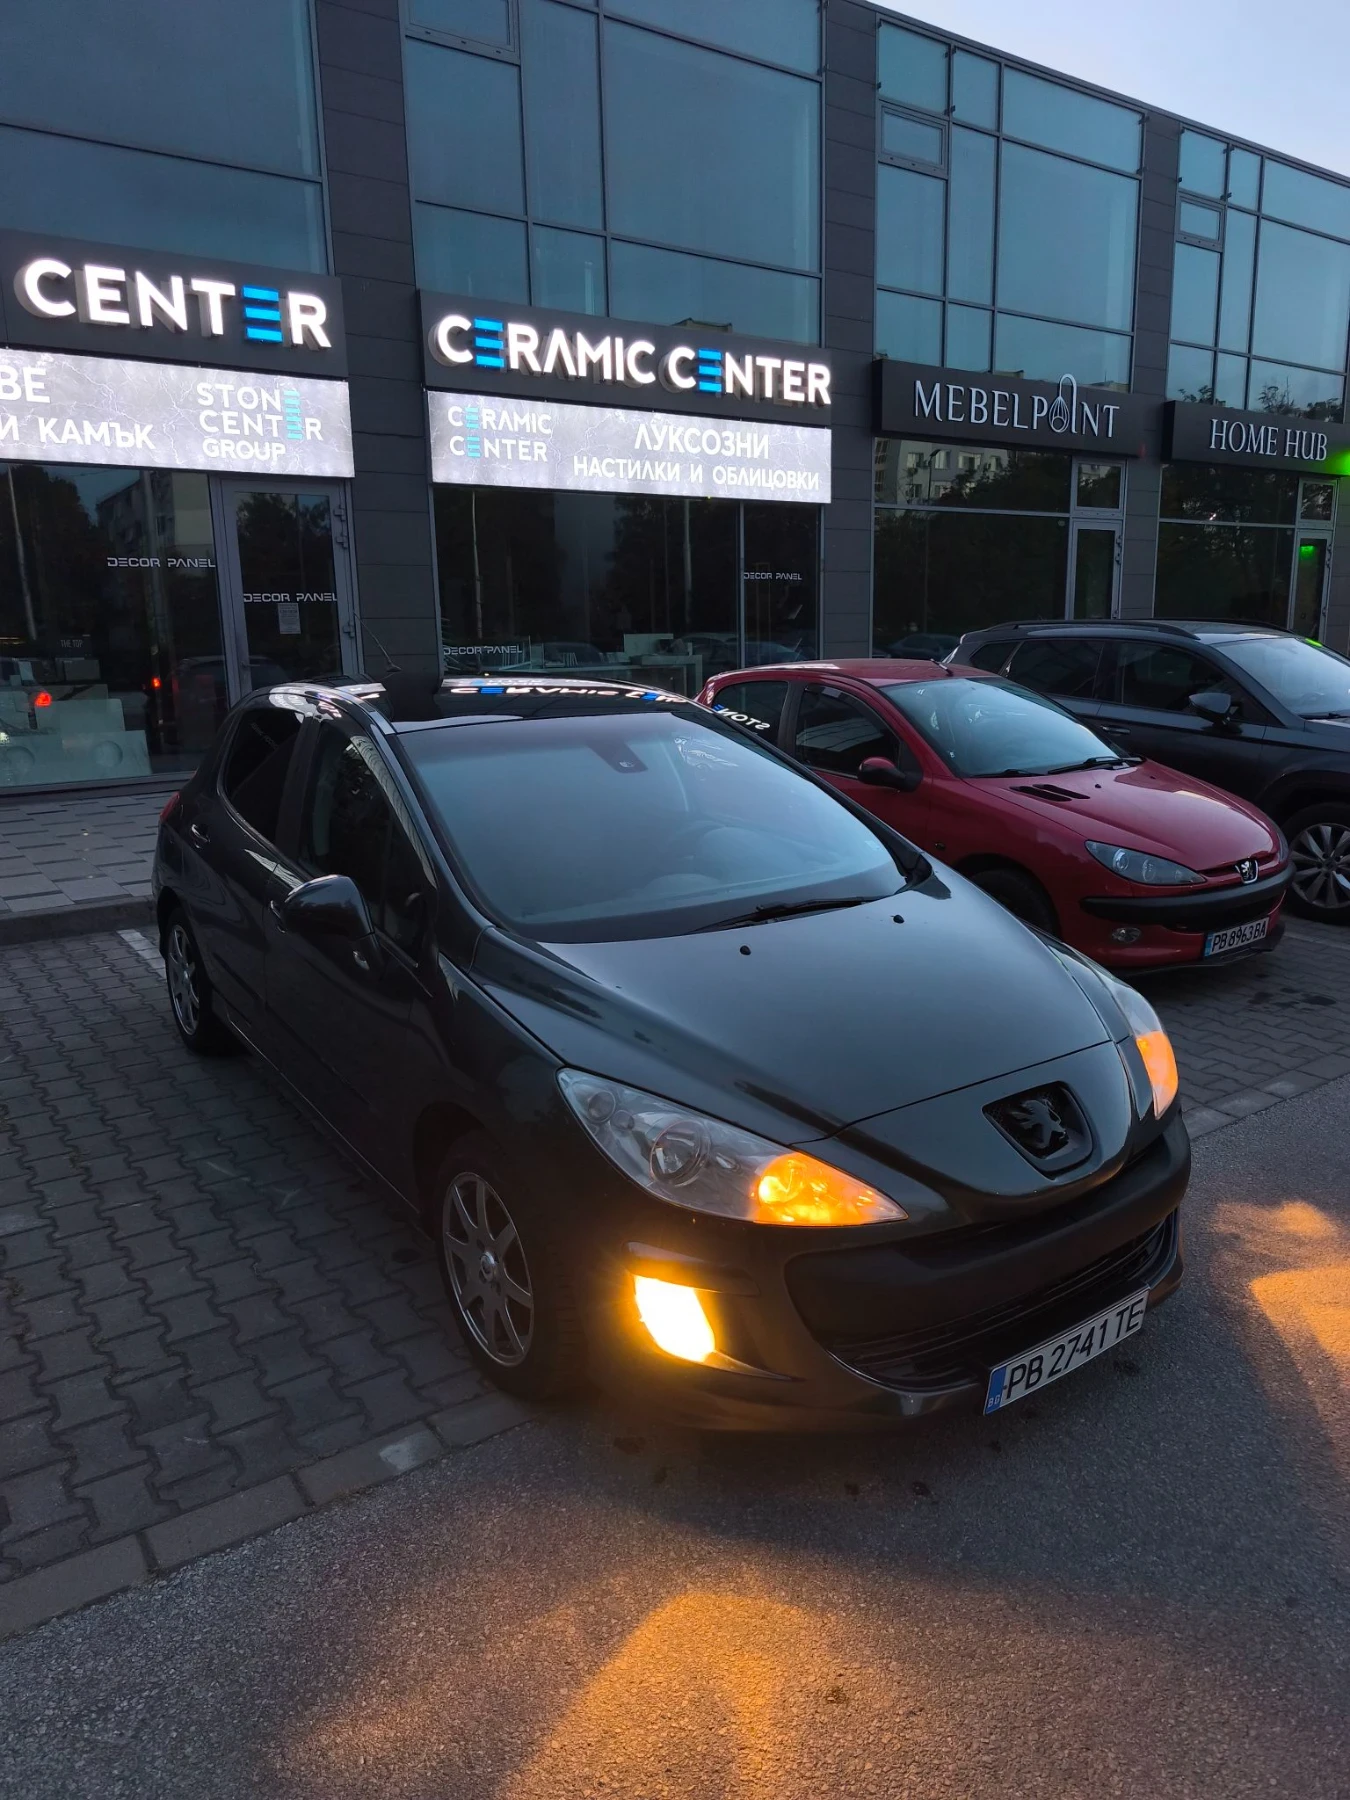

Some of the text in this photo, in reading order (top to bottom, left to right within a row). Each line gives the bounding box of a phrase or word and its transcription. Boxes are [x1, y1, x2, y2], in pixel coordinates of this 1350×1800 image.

[24, 258, 332, 348] CENTER
[437, 314, 832, 404] CERAMIC CENTER
[197, 382, 300, 413] STONE
[38, 417, 156, 450] КАМЪК
[199, 409, 323, 441] CENTER
[448, 405, 552, 435] CERAMIC
[202, 438, 286, 461] GROUP
[449, 434, 548, 462] CENTER
[633, 423, 769, 460] ЛУКСОЗНИ
[1210, 418, 1328, 462] HOME HUB
[573, 455, 820, 491] НАСТИЛКИ И ОБЛИЦОВКИ
[107, 557, 216, 568] DECOR PANEL
[743, 572, 773, 580] DECOR
[243, 592, 338, 602] DECOR PANEL
[443, 645, 522, 655] DECOR PANEL
[1228, 926, 1254, 947] 8963
[1006, 1297, 1144, 1400] PB 2741 TE
